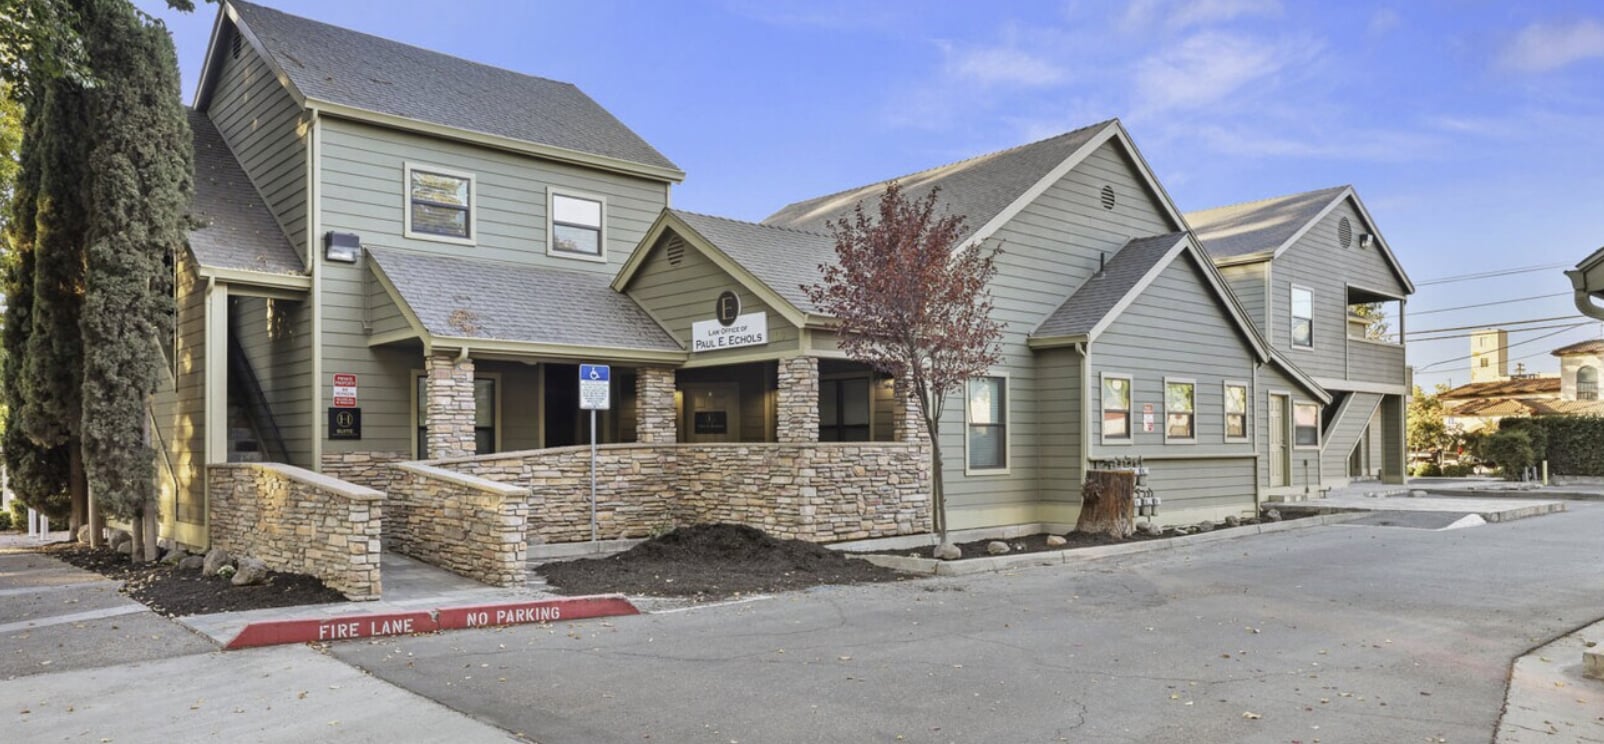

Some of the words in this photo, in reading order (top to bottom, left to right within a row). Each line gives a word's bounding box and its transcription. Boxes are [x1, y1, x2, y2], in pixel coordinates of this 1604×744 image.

[696, 340, 716, 350] PAUL
[728, 333, 762, 345] ECHOLS
[466, 612, 488, 626] NO
[497, 606, 560, 624] PARKING
[320, 622, 360, 640] FIRE
[371, 618, 414, 636] LANE
